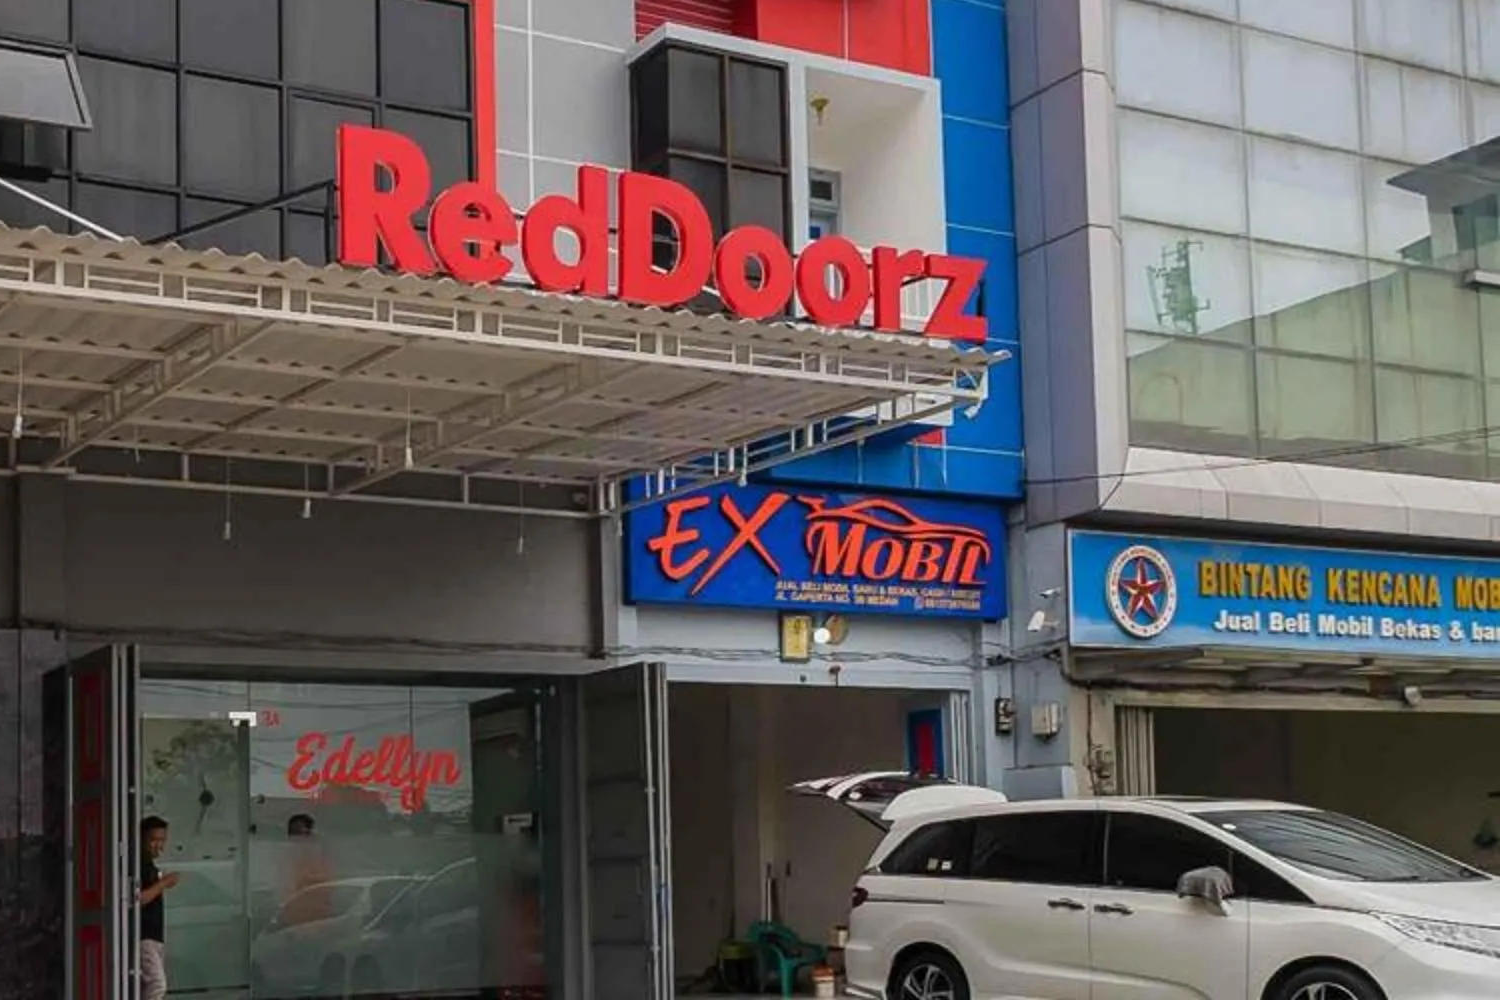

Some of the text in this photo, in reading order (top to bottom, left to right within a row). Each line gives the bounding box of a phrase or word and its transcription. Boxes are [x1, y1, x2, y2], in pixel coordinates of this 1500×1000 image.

[339, 124, 987, 340] RedDoorz
[649, 492, 791, 596] EX
[1199, 560, 1312, 600] BINTANG
[1326, 567, 1442, 608] KENCANA
[1213, 609, 1260, 633] Jual
[1267, 611, 1311, 634] Beli
[1317, 614, 1373, 638] Mobil
[1380, 616, 1441, 640] Bekas
[1450, 620, 1465, 641] &
[287, 732, 459, 812] Edellyn
